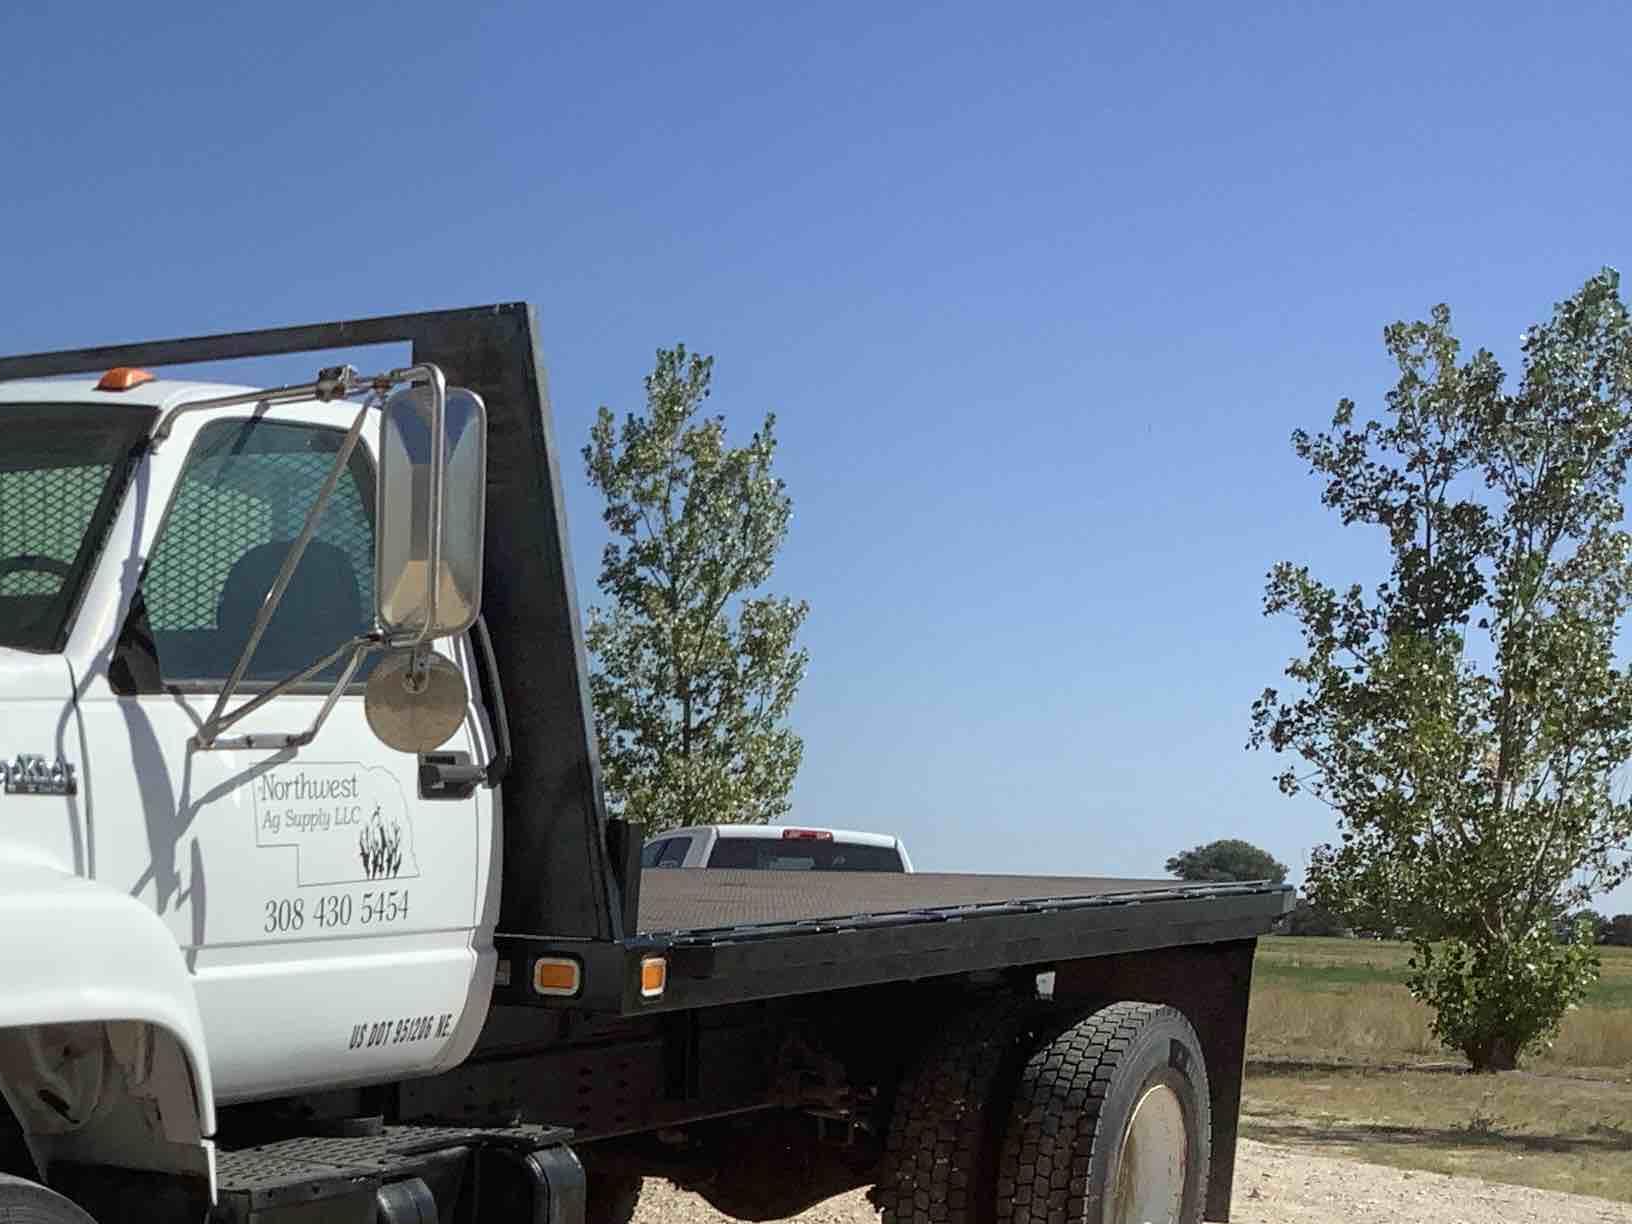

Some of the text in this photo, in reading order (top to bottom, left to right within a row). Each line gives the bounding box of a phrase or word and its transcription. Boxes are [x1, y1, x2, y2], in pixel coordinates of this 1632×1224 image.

[261, 772, 360, 801] Northwest
[262, 805, 361, 834] Ag Supply LLC
[264, 889, 409, 933] 308 430 5454
[348, 1023, 367, 1050] US
[367, 1021, 393, 1047] DOT
